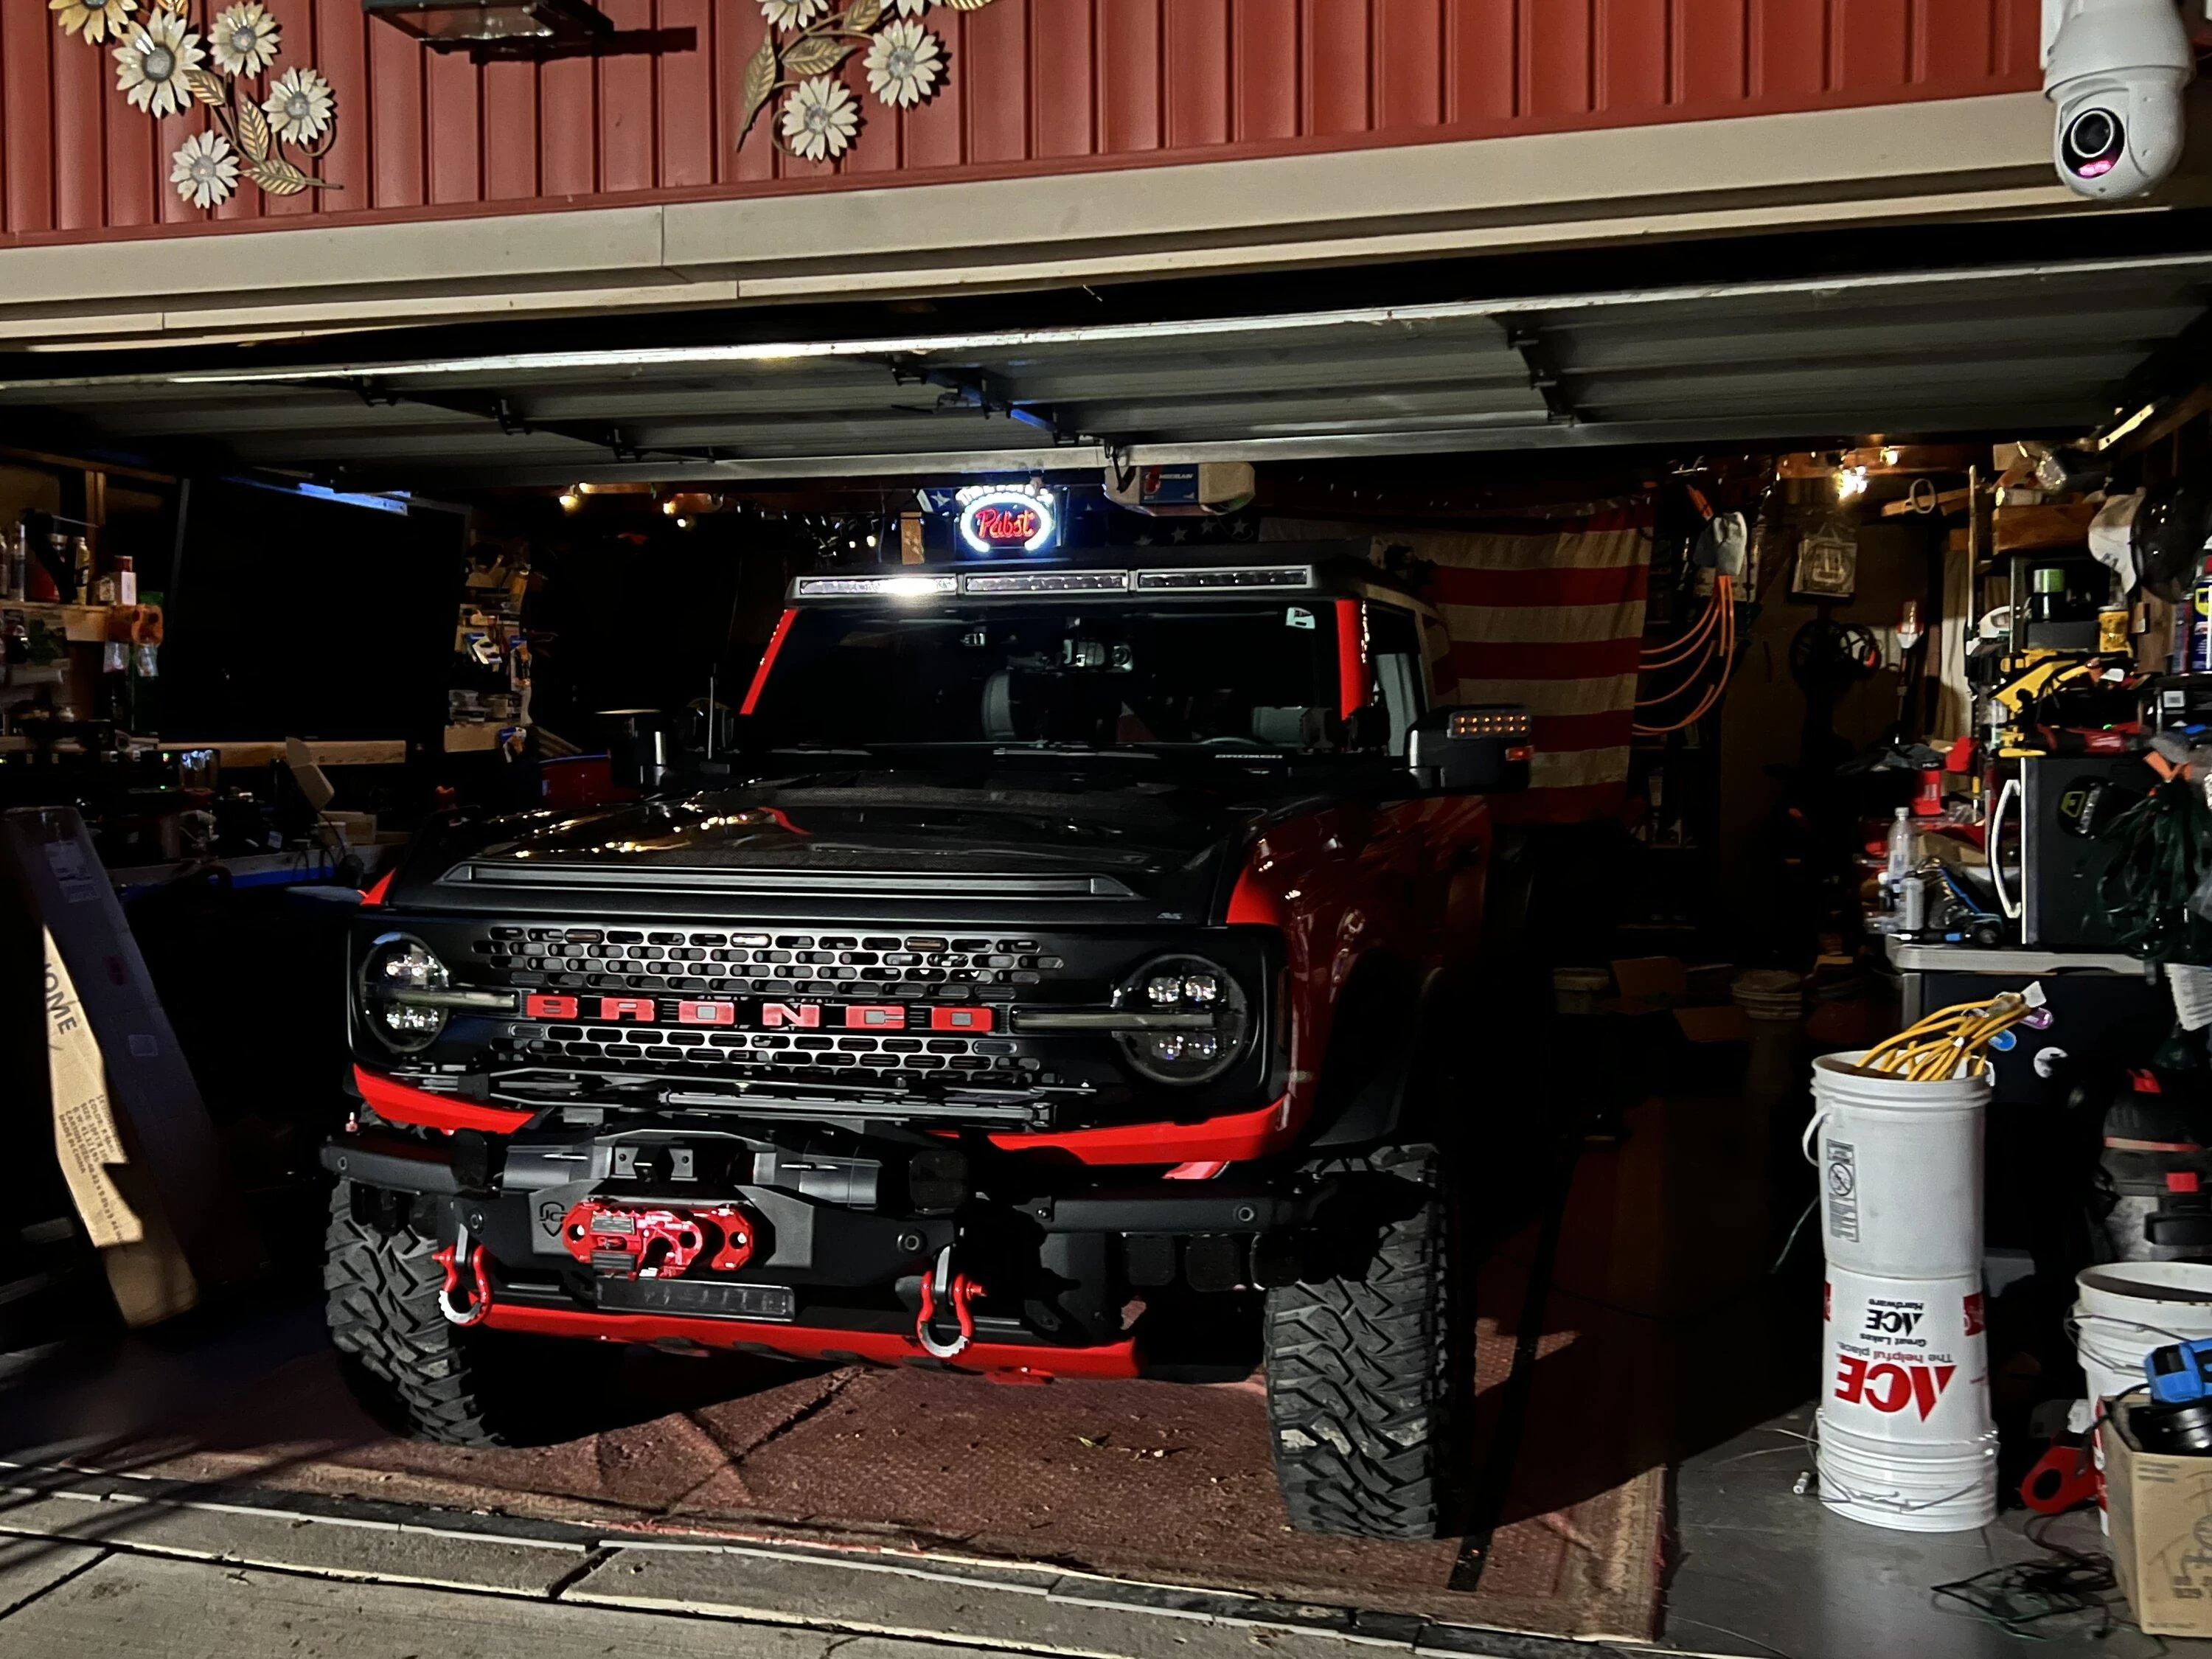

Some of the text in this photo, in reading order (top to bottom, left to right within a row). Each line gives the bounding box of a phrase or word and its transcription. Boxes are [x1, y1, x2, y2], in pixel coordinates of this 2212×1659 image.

[975, 507, 1036, 539] Pabst
[45, 962, 77, 1034] OME
[526, 995, 993, 1032] BRONCO
[1868, 1298, 1924, 1310] Hardware
[1865, 1308, 1924, 1337] ACE
[1859, 1332, 1927, 1348] Great Lakes
[1873, 1350, 1924, 1363] helpful
[1928, 1354, 1953, 1363] The
[1834, 1353, 1957, 1423] ACE
